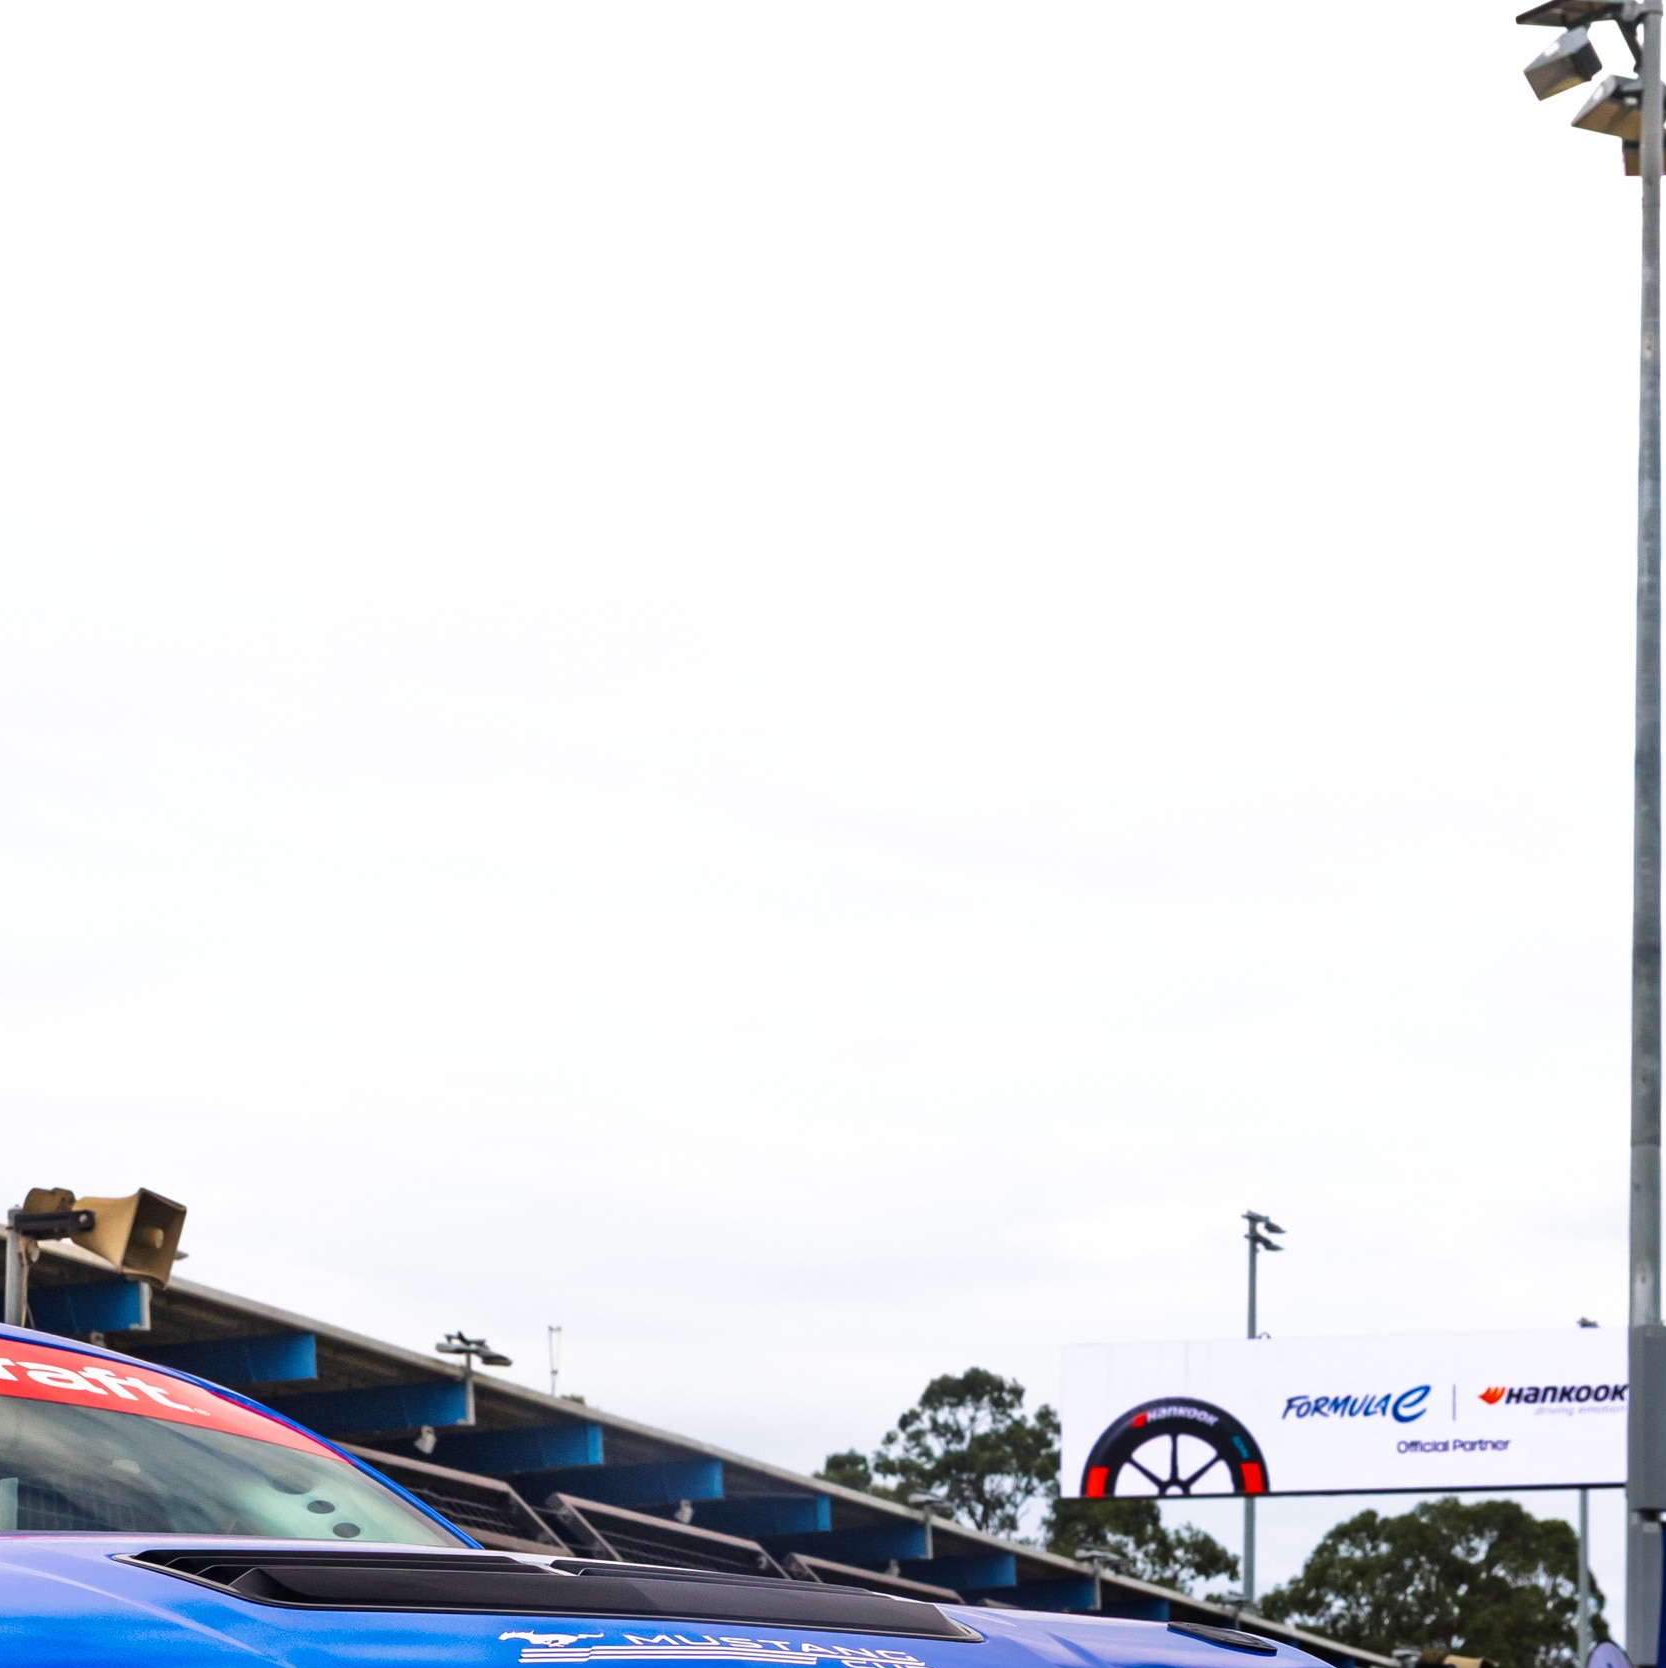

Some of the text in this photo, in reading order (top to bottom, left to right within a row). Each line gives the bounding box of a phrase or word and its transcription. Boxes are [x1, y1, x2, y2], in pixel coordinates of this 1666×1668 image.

[1282, 1394, 1391, 1420] FORMULA
[1397, 1438, 1511, 1454] Official Partner
[623, 1634, 919, 1662] MUSTANG
